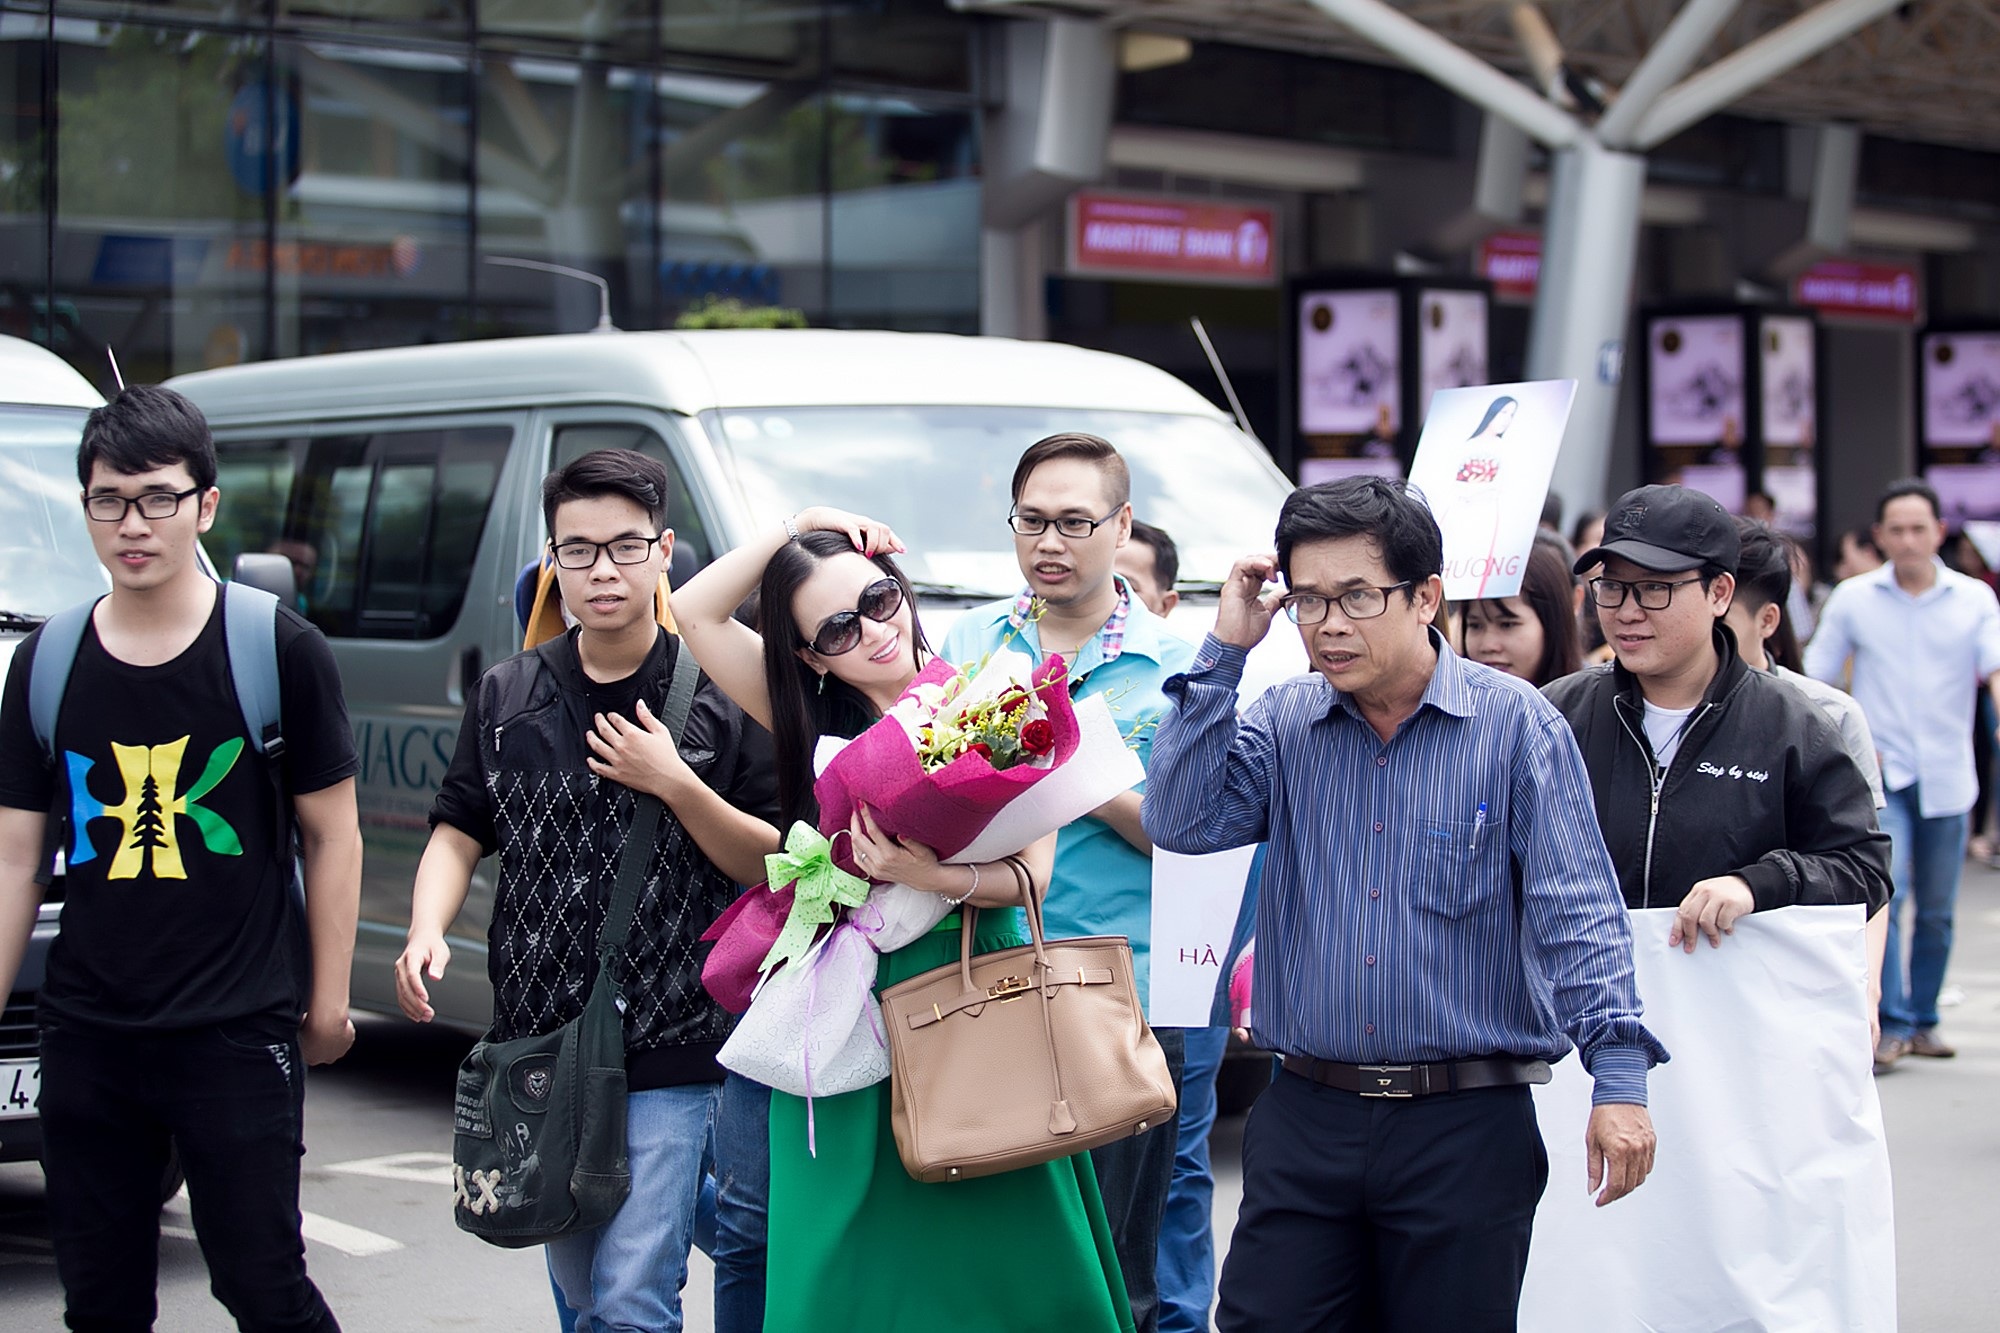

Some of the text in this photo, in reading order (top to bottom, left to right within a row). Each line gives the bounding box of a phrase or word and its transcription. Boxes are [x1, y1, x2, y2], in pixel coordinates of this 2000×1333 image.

[1696, 762, 1769, 783] Step by step
[1179, 943, 1219, 967] HÀ
